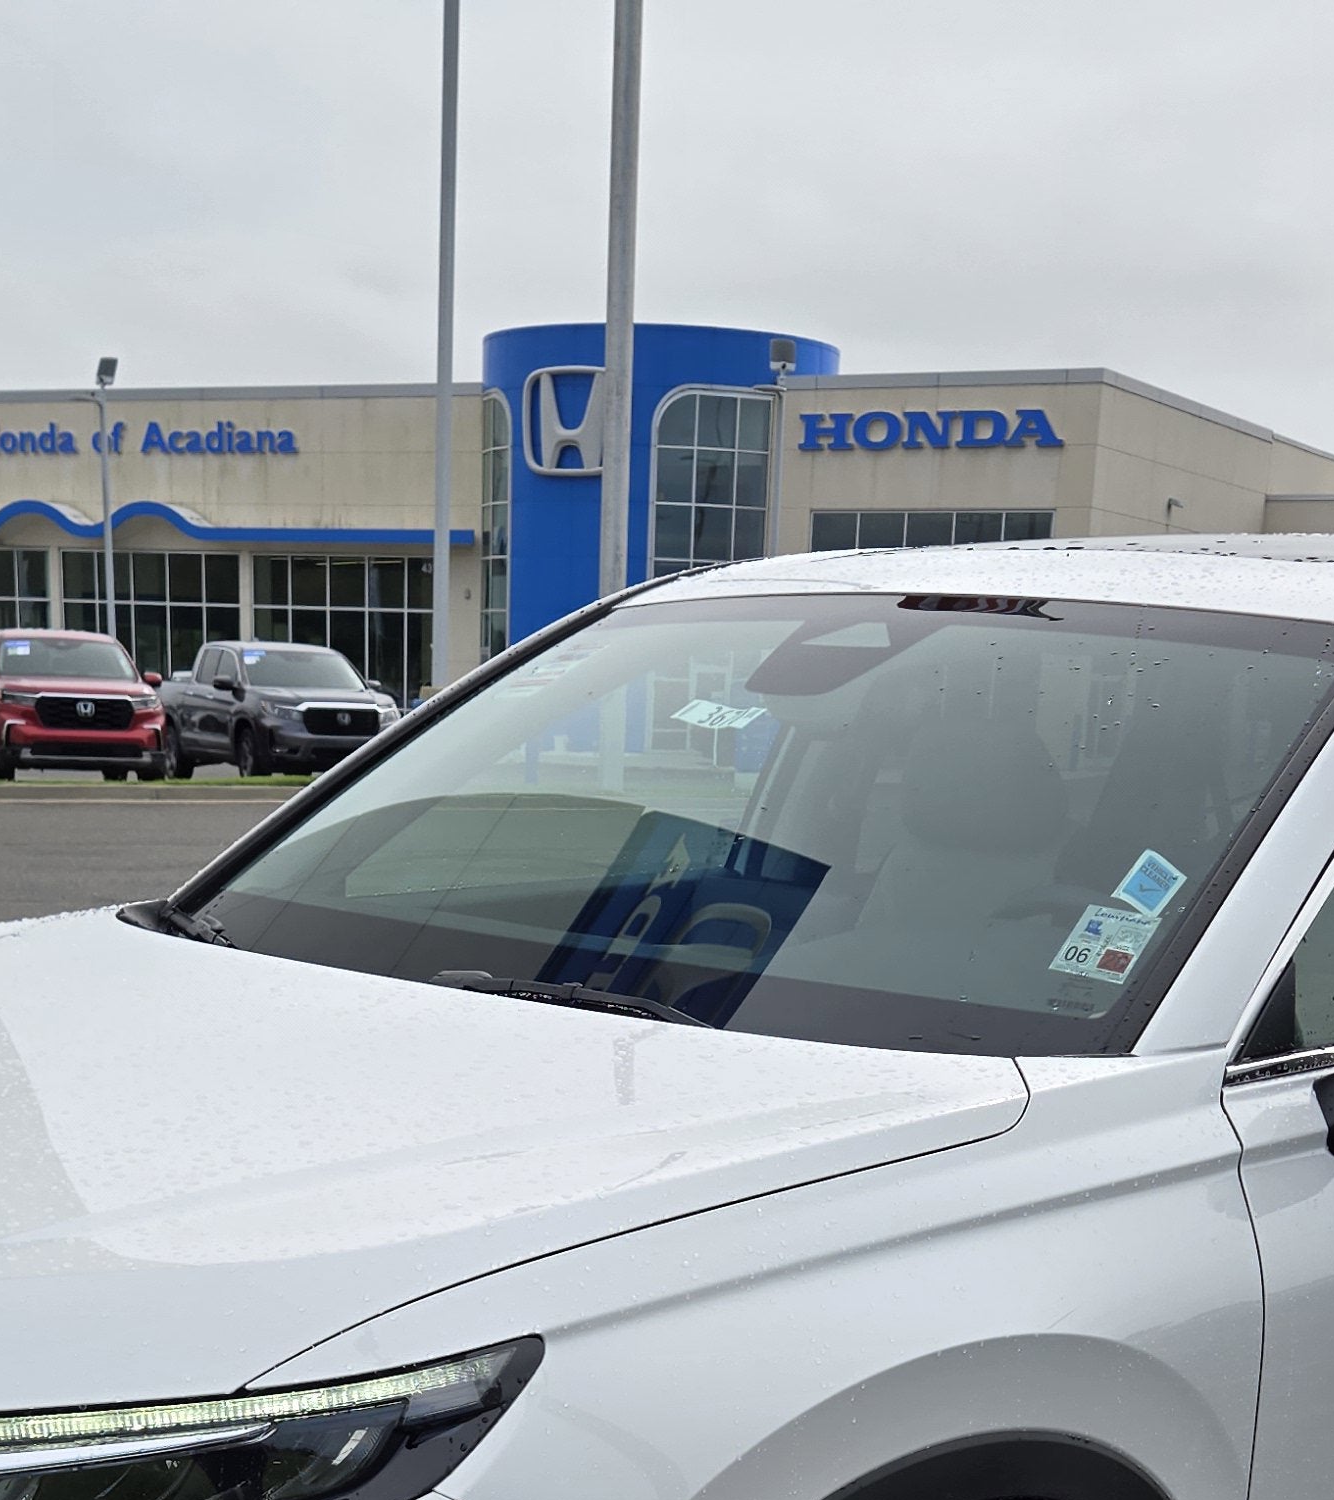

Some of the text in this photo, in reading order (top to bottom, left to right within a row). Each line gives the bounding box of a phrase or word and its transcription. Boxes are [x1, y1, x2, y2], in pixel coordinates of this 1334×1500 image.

[91, 422, 125, 454] of
[140, 421, 297, 454] Acadiana
[798, 409, 1064, 451] HONDA
[1064, 945, 1091, 964] 06
